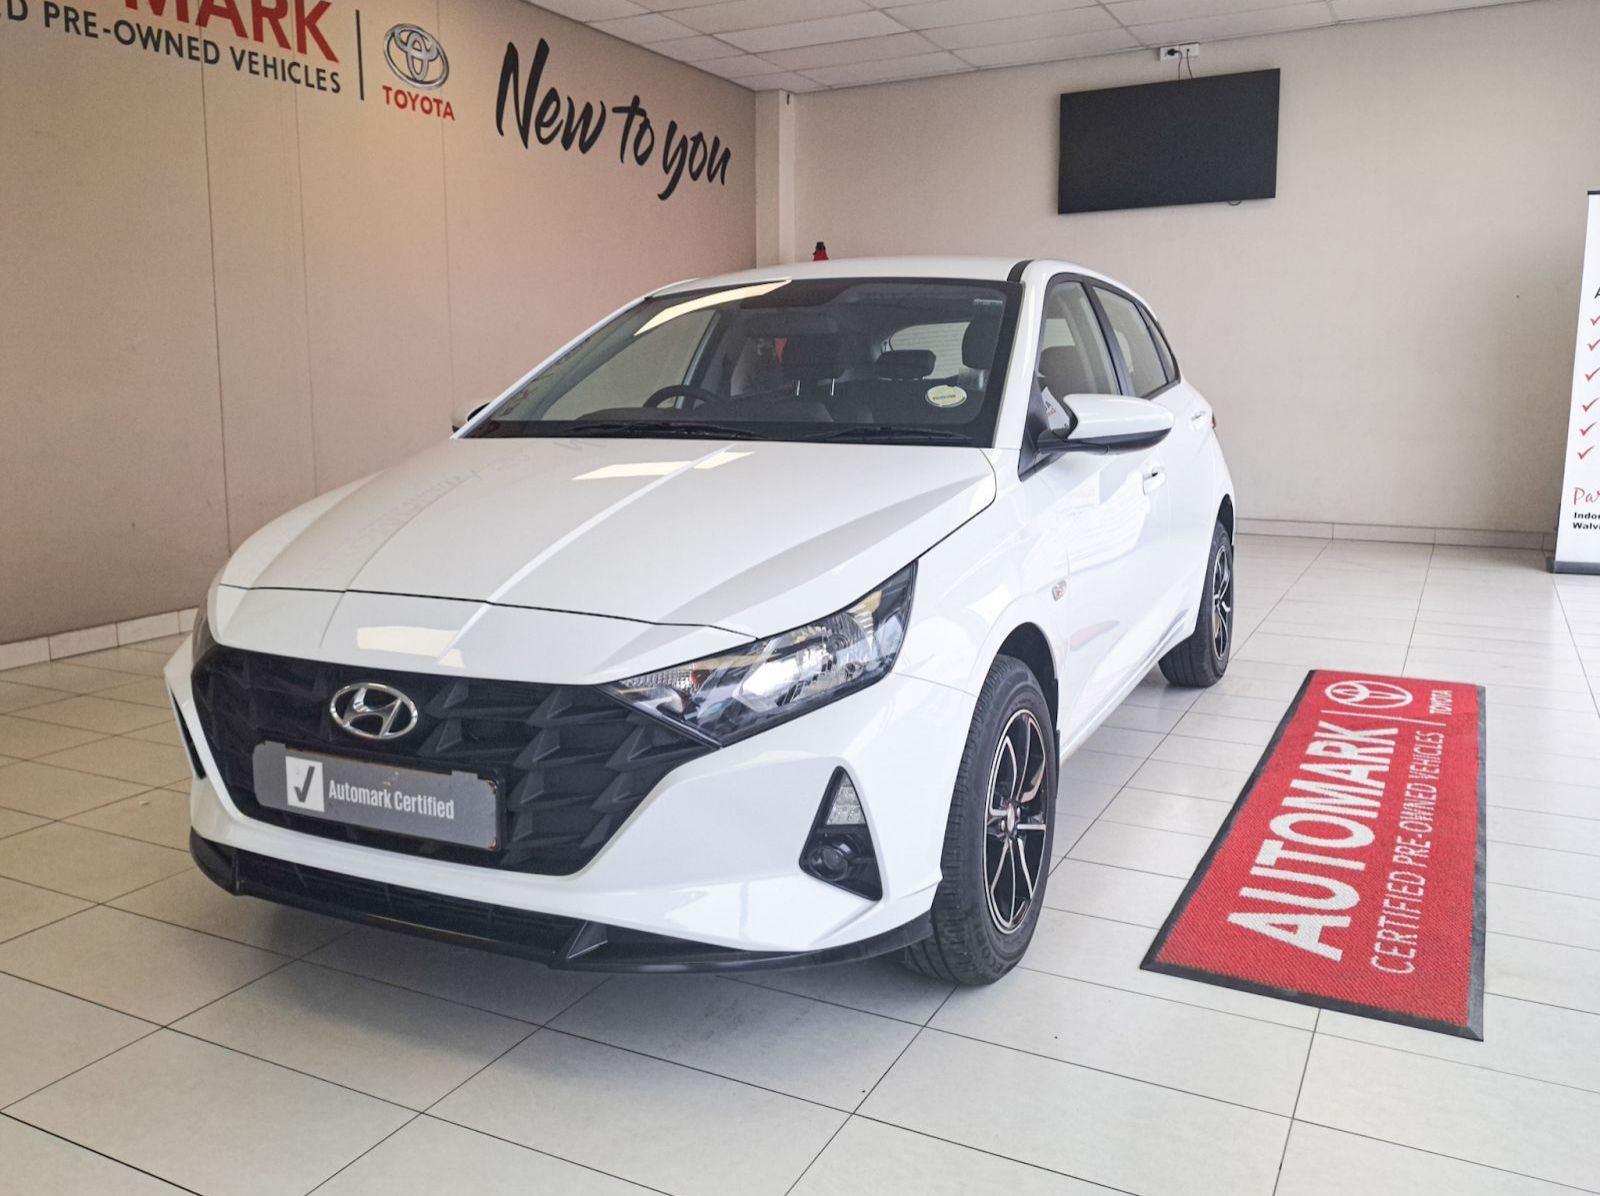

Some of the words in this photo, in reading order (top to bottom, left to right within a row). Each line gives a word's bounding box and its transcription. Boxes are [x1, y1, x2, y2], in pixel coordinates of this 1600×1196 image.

[43, 0, 220, 65] PRE-OWNED
[229, 46, 341, 94] VEHICLES
[124, 0, 340, 64] ARK
[382, 85, 455, 121] TOYOTA
[495, 37, 607, 154] New
[611, 94, 655, 166] to
[657, 119, 731, 201] you
[1572, 521, 1600, 530] Walv
[1573, 511, 1600, 519] Indo
[1429, 689, 1453, 716] TOYOTA
[1408, 730, 1445, 780] VEHICLES
[328, 779, 393, 810] Automark
[393, 790, 455, 820] Certified
[1392, 782, 1438, 868] PRE-OWNED
[1226, 720, 1399, 963] AUTOMARK
[1370, 870, 1426, 975] CERTIFIED
